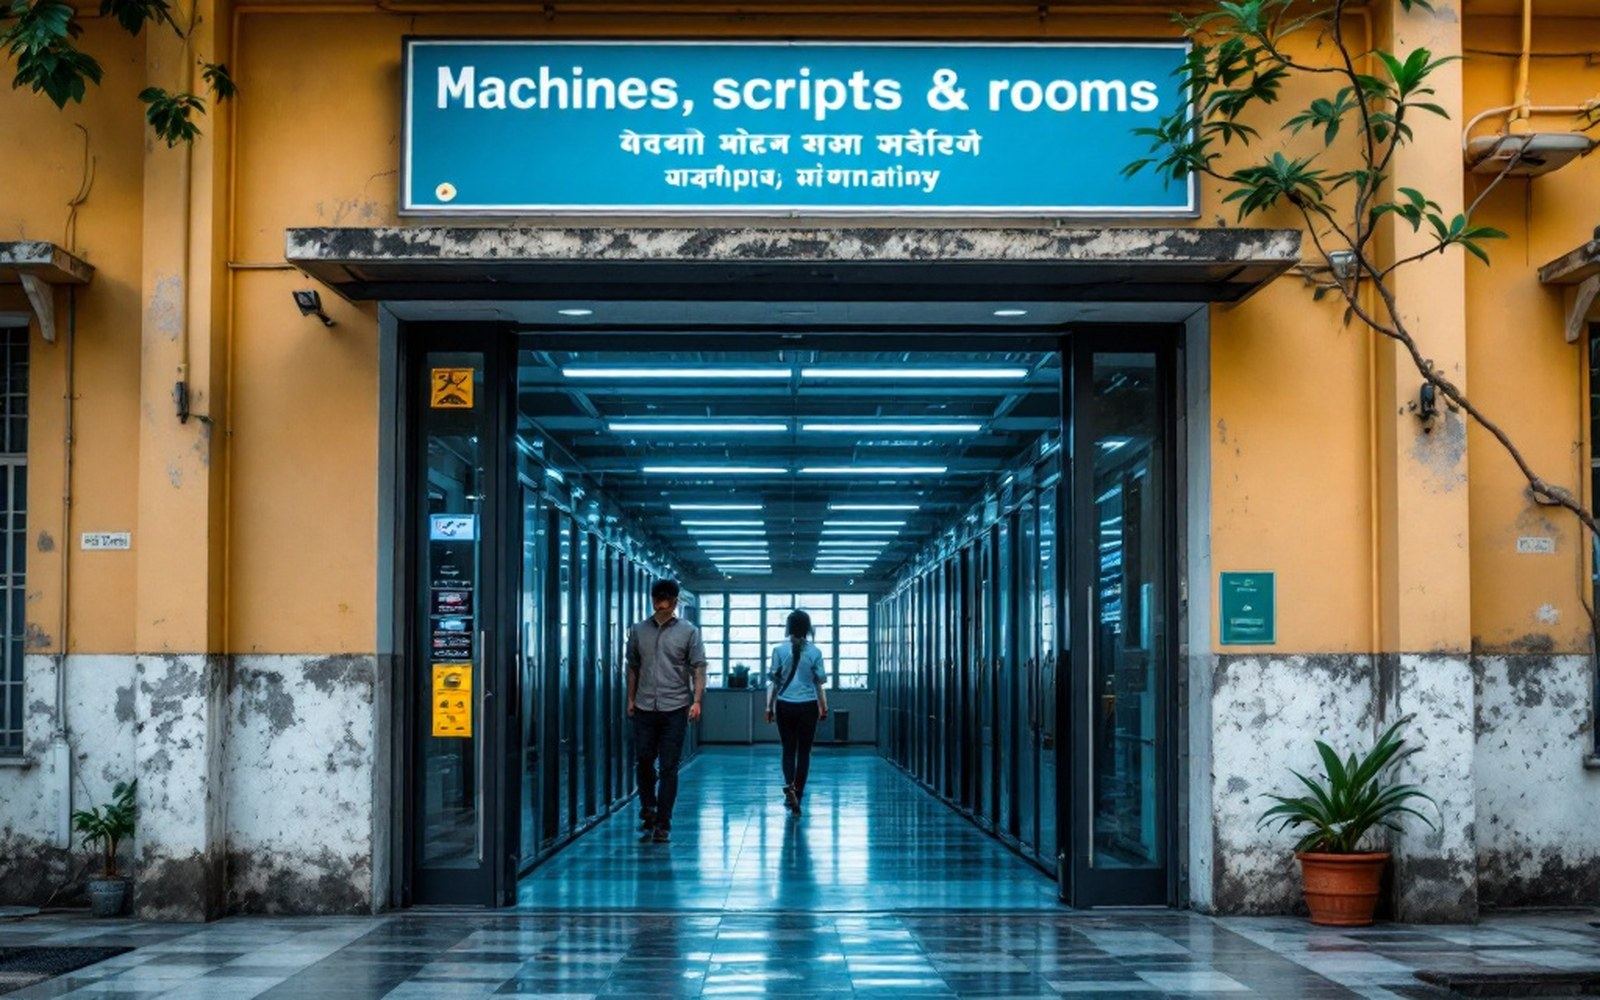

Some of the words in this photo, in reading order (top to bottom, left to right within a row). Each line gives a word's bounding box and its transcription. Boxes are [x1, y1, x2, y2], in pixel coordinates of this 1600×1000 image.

[436, 65, 694, 117] Machines,
[713, 67, 902, 121] scripts
[926, 68, 969, 111] &
[988, 79, 1159, 112] rooms
